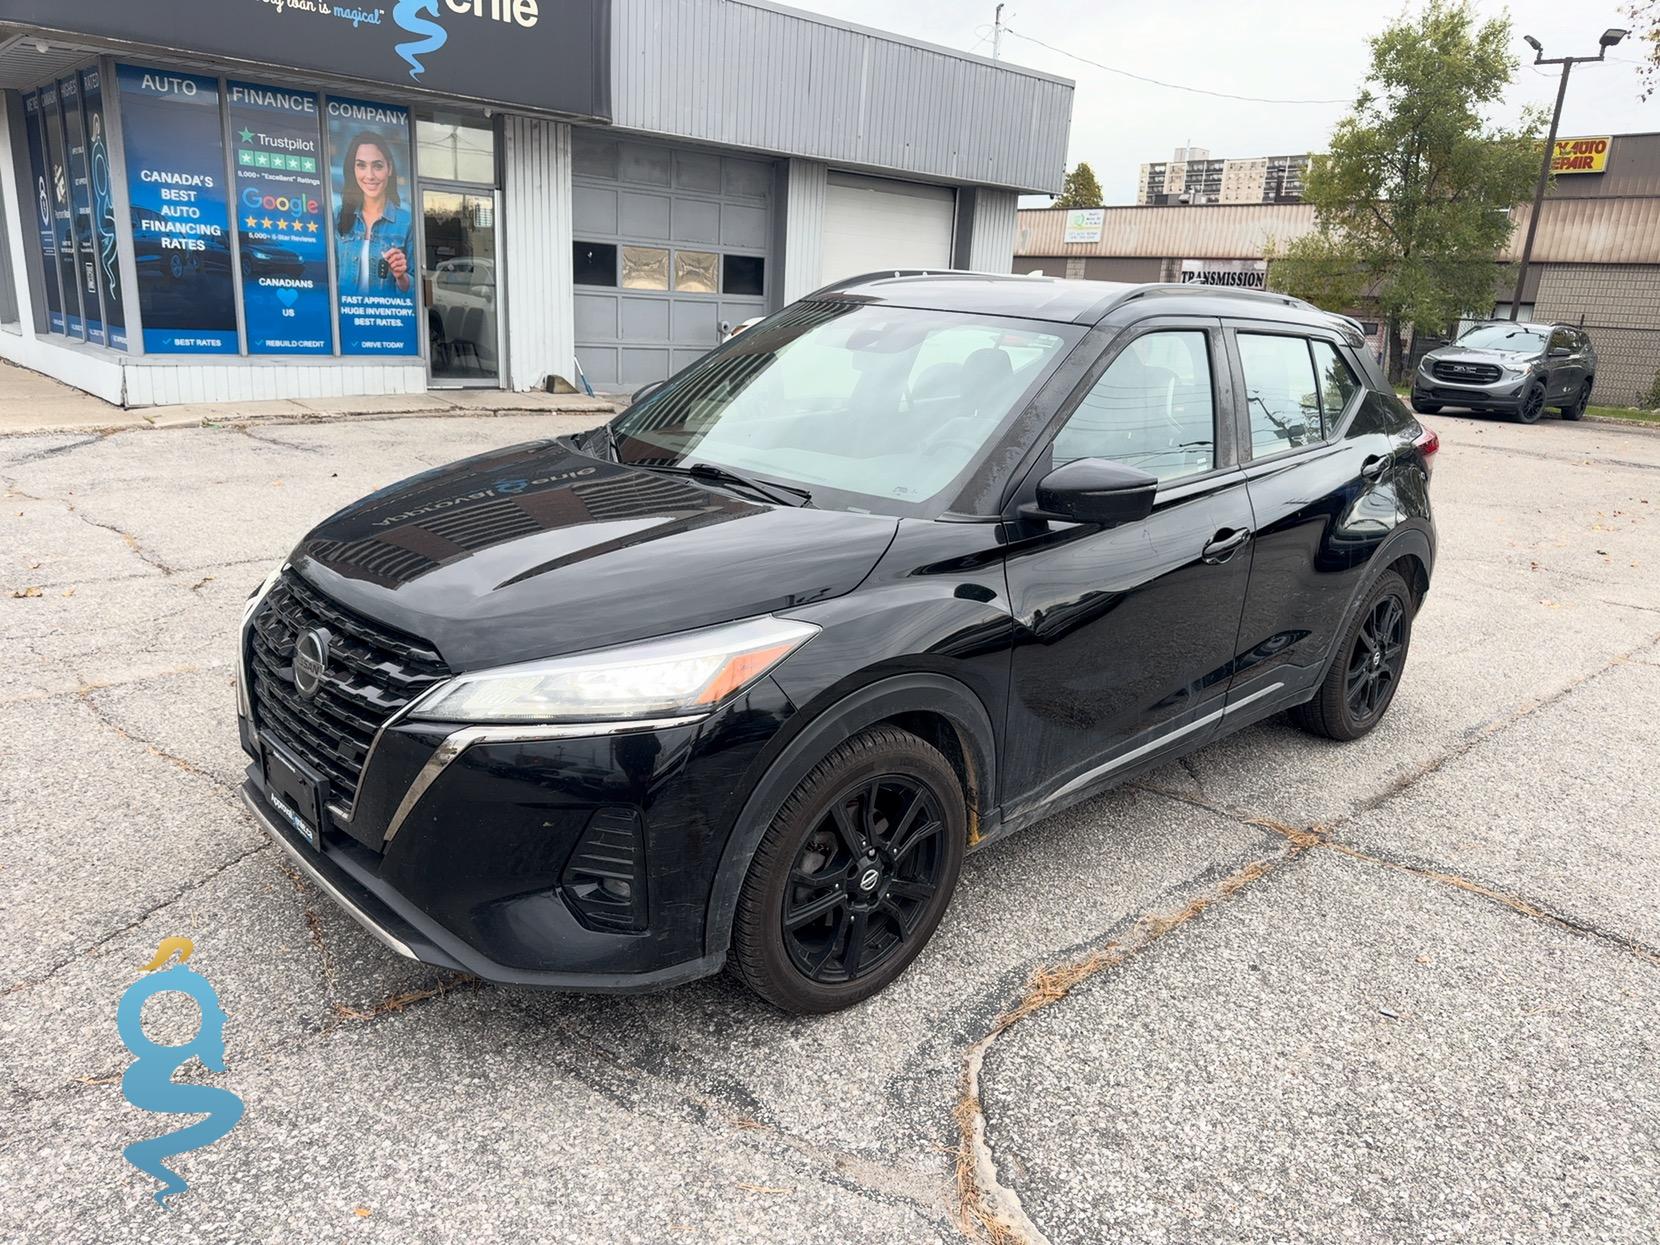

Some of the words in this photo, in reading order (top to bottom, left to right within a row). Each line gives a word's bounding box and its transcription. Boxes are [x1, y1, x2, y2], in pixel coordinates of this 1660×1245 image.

[319, 0, 331, 14] is
[141, 74, 197, 96] AUTO
[232, 87, 314, 112] FINANCE
[328, 102, 408, 126] COMPANY
[257, 133, 315, 151] Trustpilot
[1570, 140, 1607, 155] AUTO
[1551, 155, 1595, 171] EPAIR
[140, 170, 214, 188] CANADA'S
[297, 176, 320, 186] Ratings
[161, 188, 197, 202] BEST
[242, 187, 319, 217] Google
[161, 205, 200, 219] AUTO
[141, 219, 221, 236] FINANCING
[161, 237, 206, 251] RATES
[290, 234, 317, 243] Reviews
[258, 277, 314, 288] CANADIANS
[1181, 271, 1265, 287] TRANSMISSION
[341, 295, 363, 305] FAST
[363, 296, 413, 306] APPROVALS.
[281, 308, 295, 317] US
[340, 307, 365, 316] HUGE
[365, 307, 415, 317] INVENTORY.
[353, 317, 374, 326] BEST
[375, 318, 404, 327] RATES.
[174, 338, 195, 346] BEST
[196, 338, 222, 347] RATES
[298, 340, 325, 348] CREDIT
[382, 341, 404, 349] TODAY
